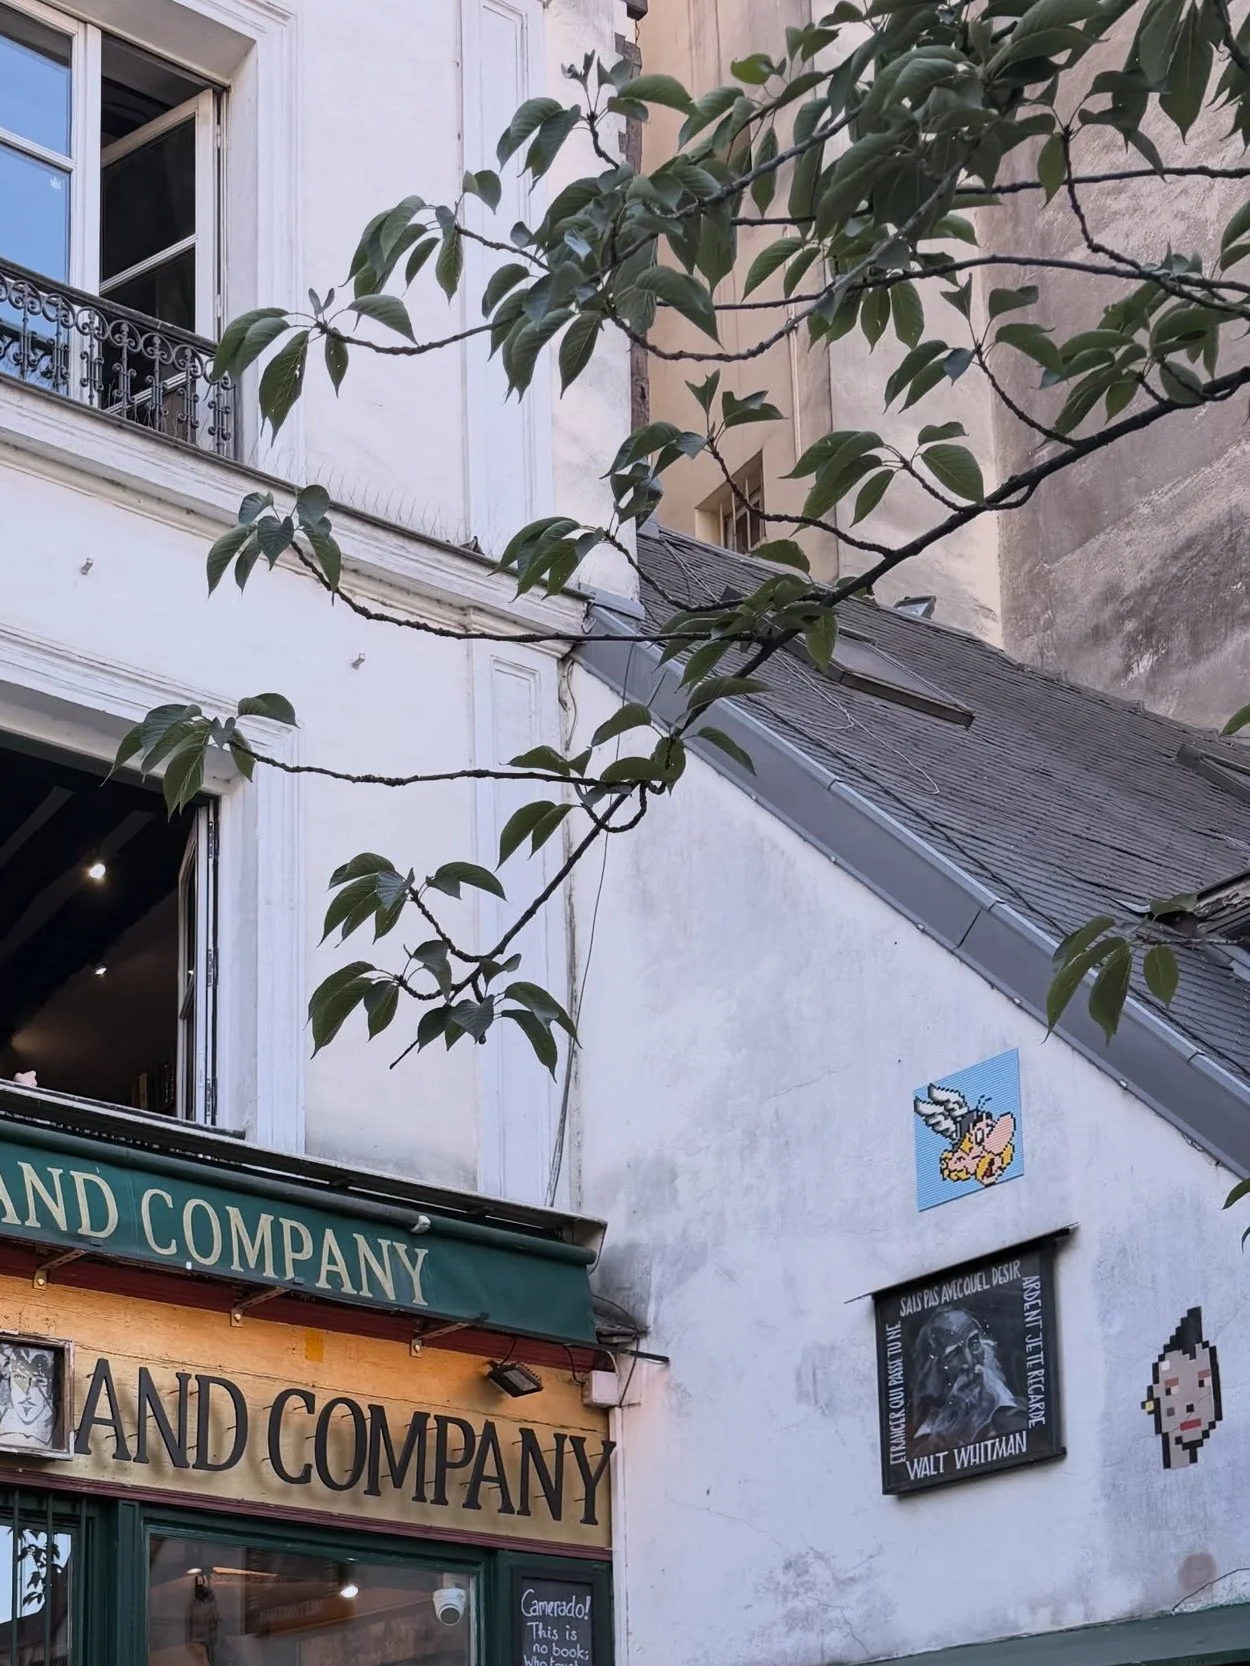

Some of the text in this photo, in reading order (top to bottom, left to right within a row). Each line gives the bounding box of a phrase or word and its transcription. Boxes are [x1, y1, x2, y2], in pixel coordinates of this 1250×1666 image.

[141, 1188, 429, 1306] COMPANY
[899, 1294, 922, 1317] SAIS
[923, 1287, 940, 1310] PAS
[1022, 1275, 1042, 1328] ARDENT
[74, 1357, 247, 1472] AND
[268, 1388, 616, 1526] COMPANY
[906, 1430, 1028, 1481] WALT WHITMAN
[521, 1589, 592, 1620] Camerado!
[526, 1622, 578, 1641] This is
[533, 1642, 589, 1660] no book;
